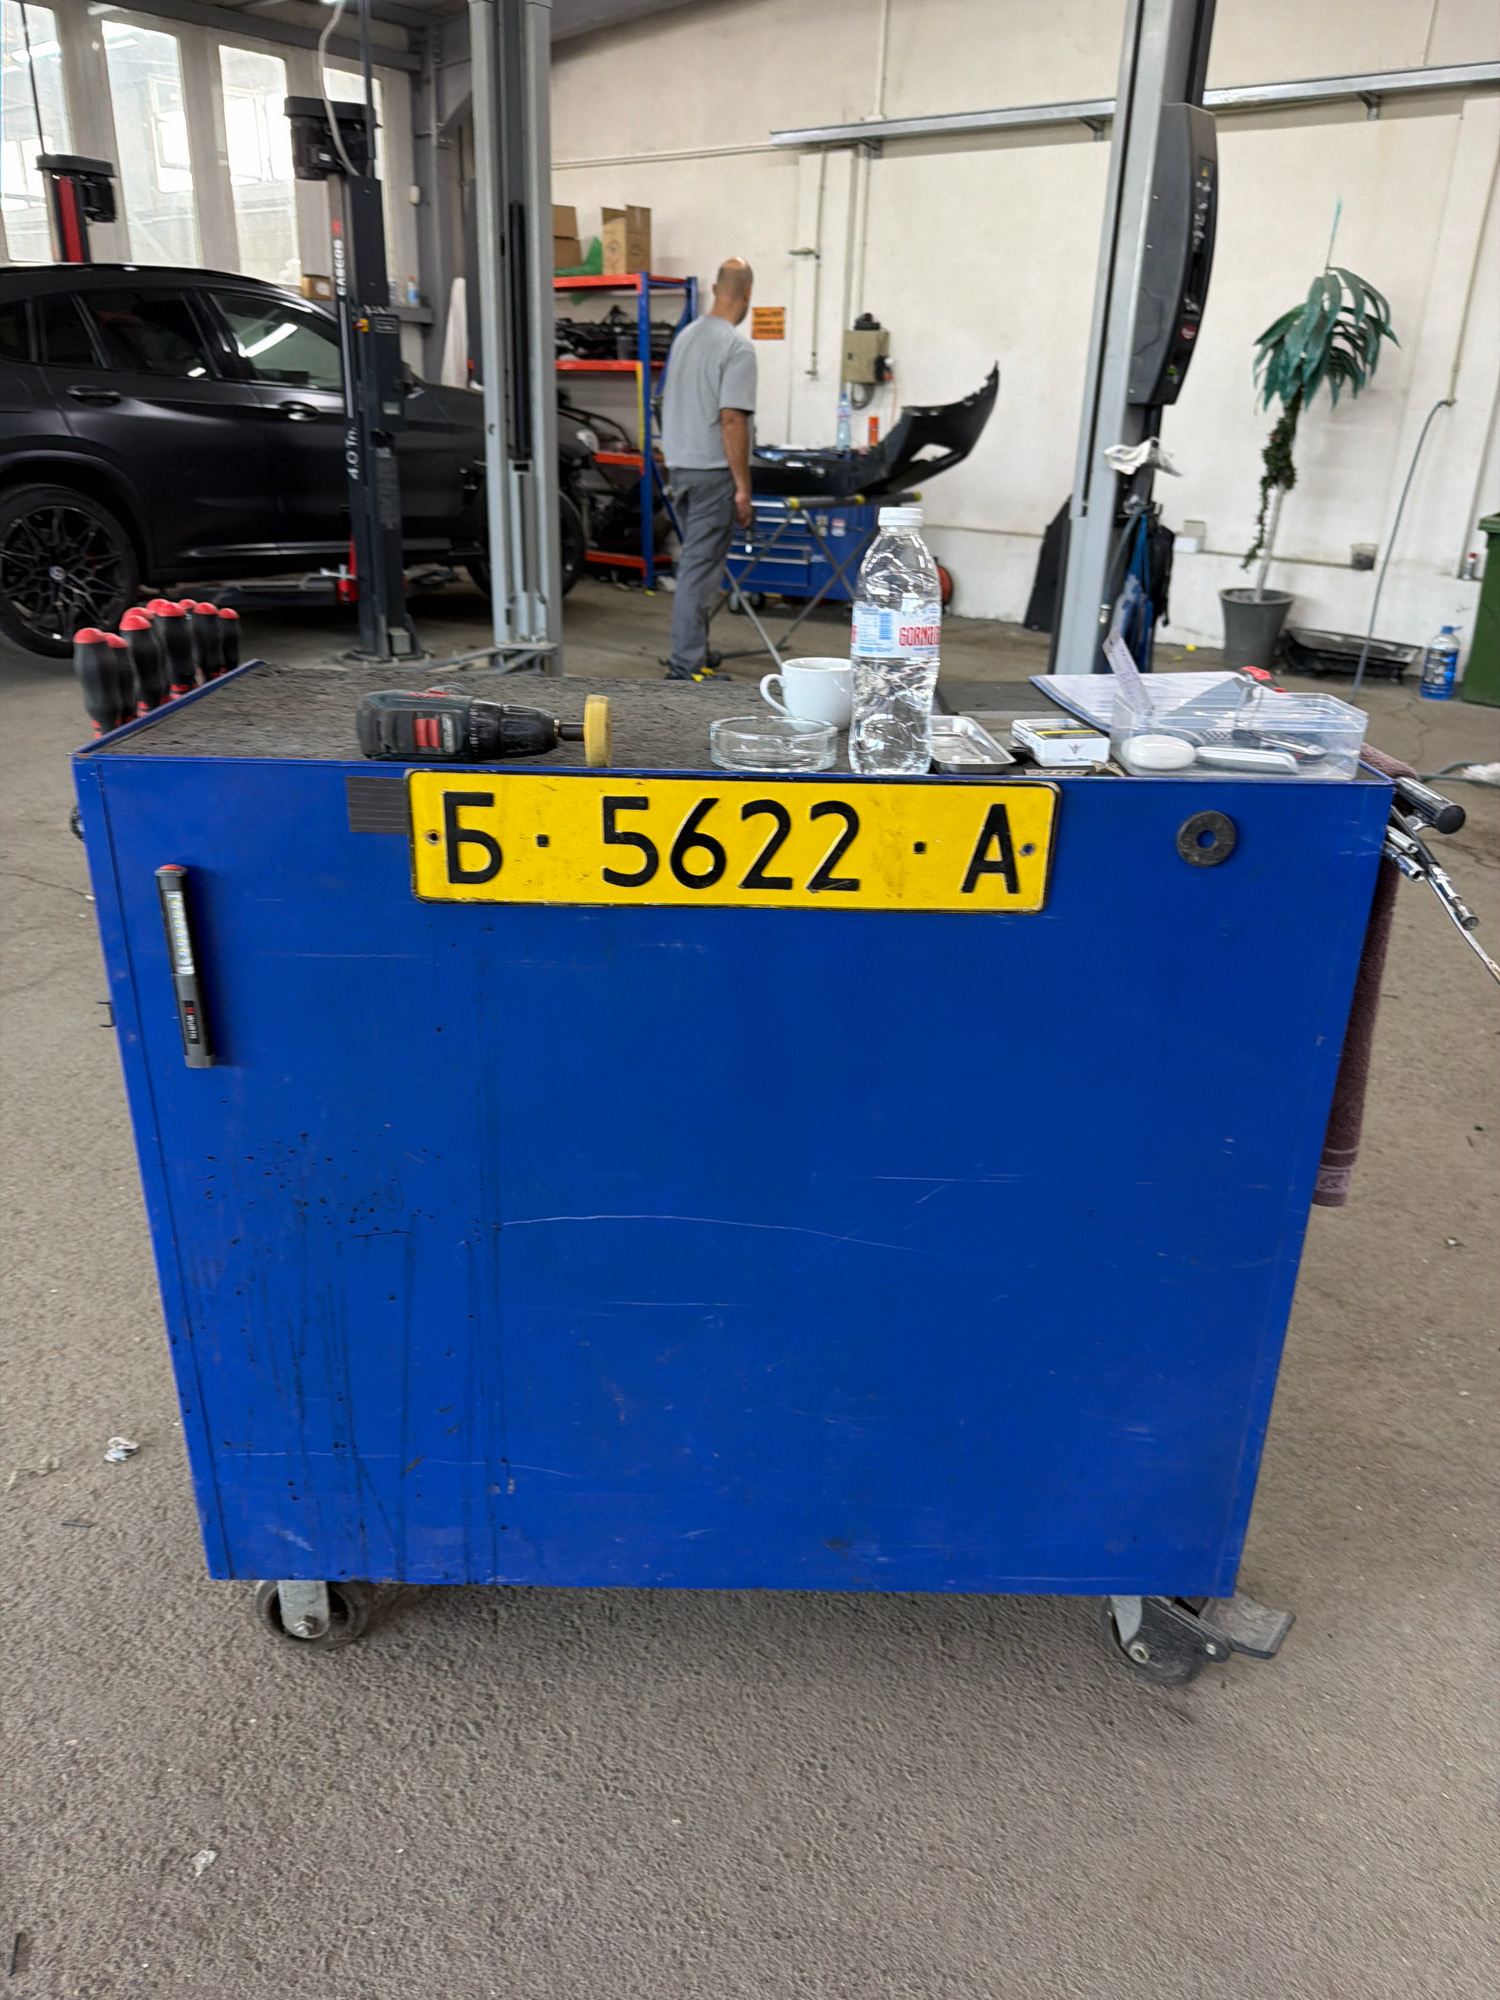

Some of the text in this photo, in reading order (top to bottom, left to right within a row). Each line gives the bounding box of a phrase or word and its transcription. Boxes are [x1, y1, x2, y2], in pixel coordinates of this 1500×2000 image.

[441, 790, 1020, 894] Б 5622 А
